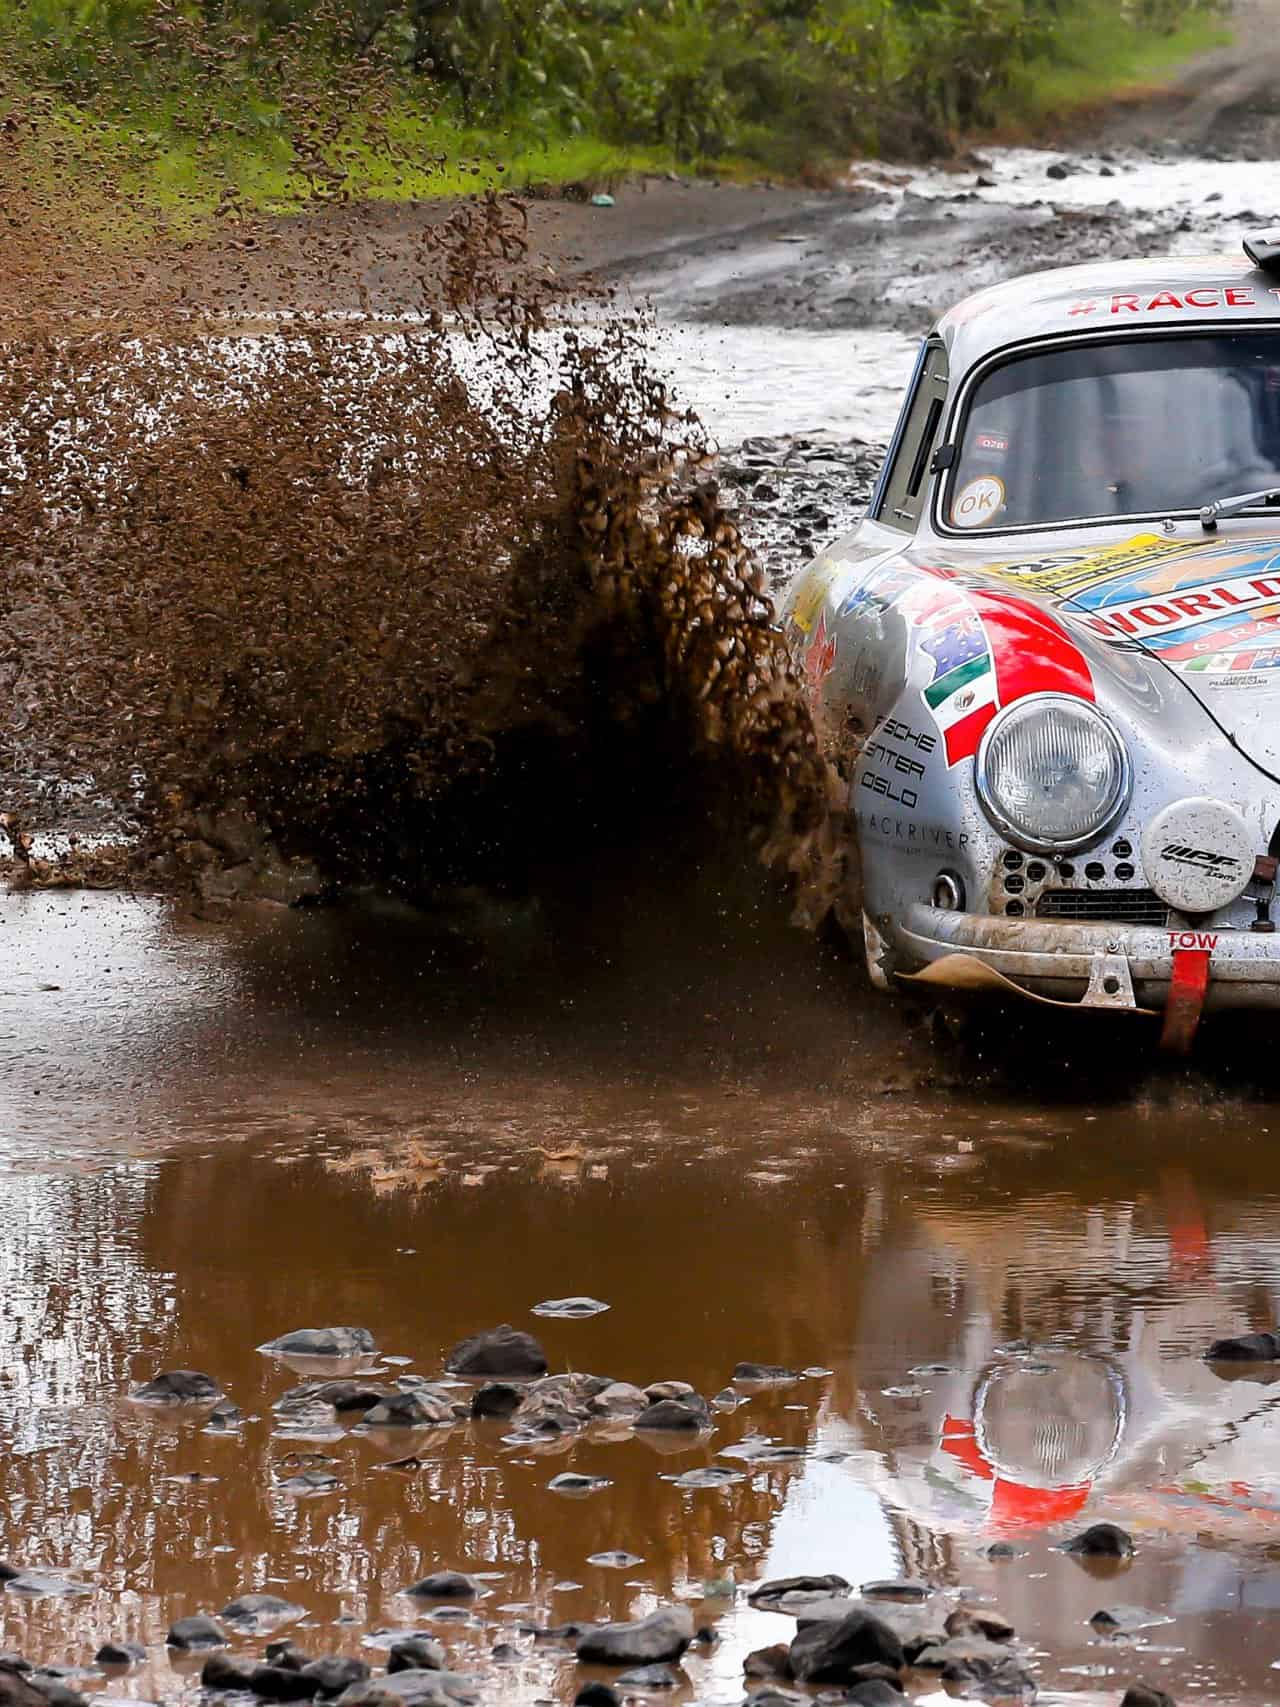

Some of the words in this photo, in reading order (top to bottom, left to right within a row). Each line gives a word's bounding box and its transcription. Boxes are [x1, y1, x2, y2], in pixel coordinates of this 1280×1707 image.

[960, 490, 995, 514] OK
[861, 771, 918, 808] OSLO
[1166, 931, 1218, 949] TOW
